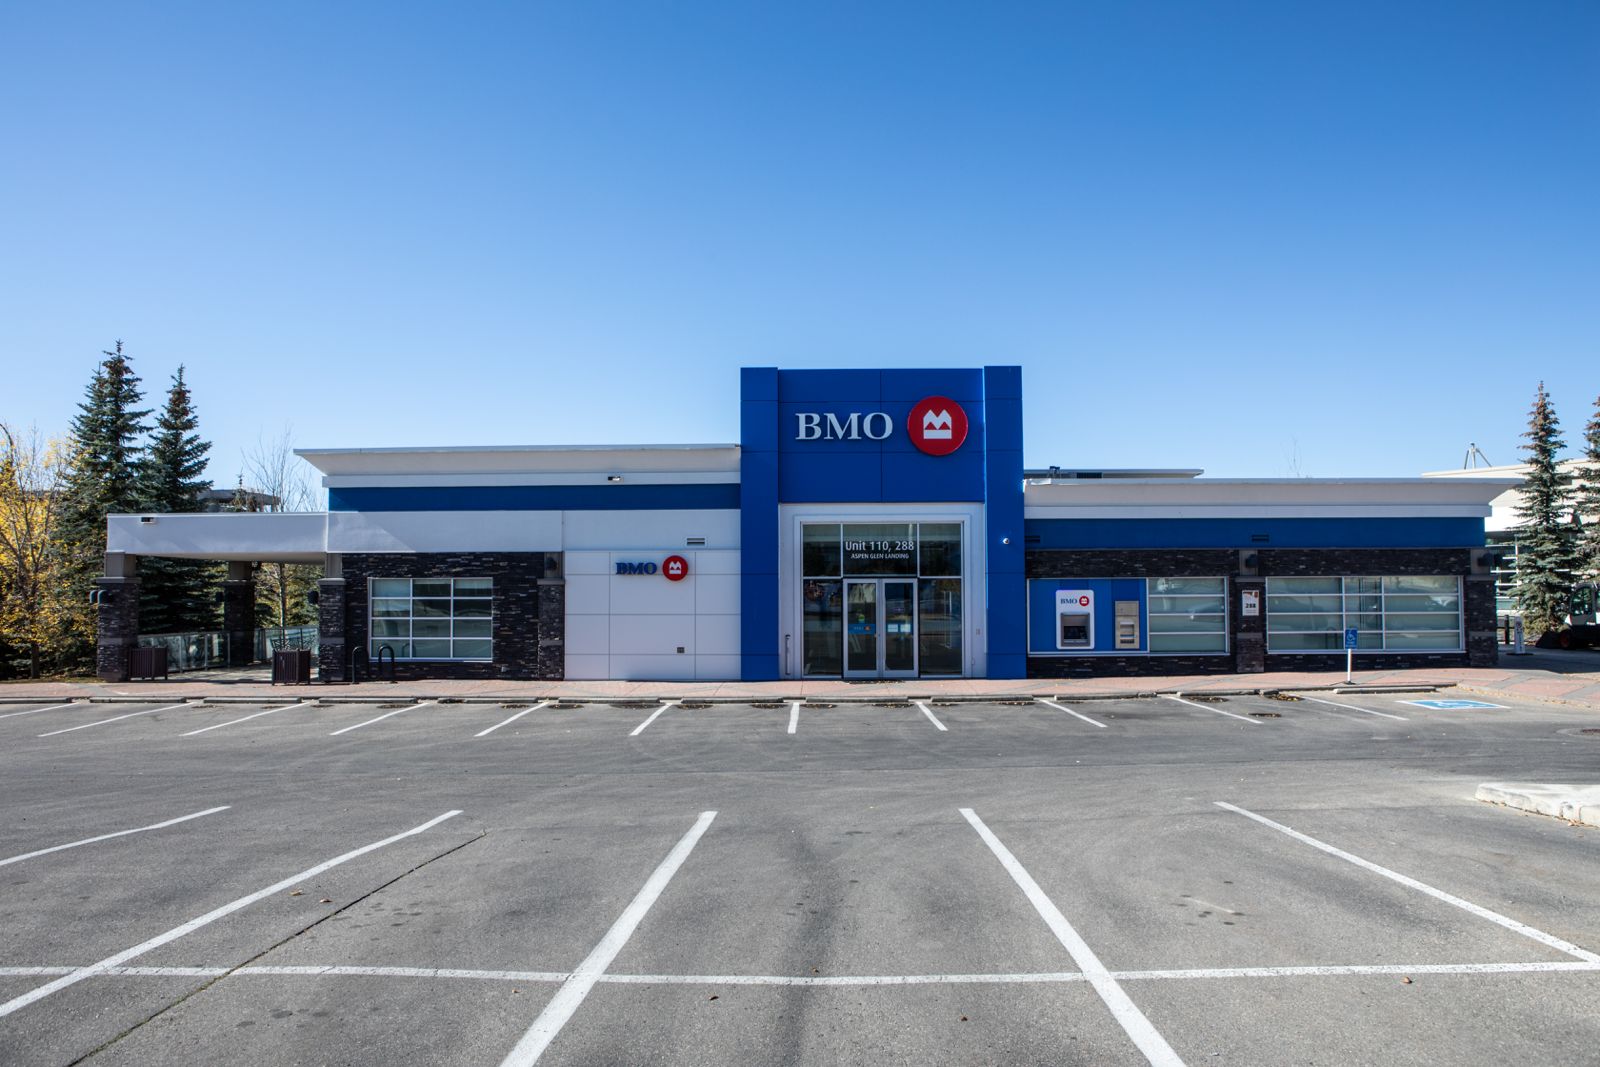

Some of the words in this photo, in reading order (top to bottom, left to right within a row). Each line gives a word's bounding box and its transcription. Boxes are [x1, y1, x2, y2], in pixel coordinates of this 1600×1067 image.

[795, 412, 893, 440] BMO
[845, 541, 866, 551] Unit
[869, 541, 892, 553] 110,
[895, 541, 915, 551] 288
[615, 562, 658, 575] BMO
